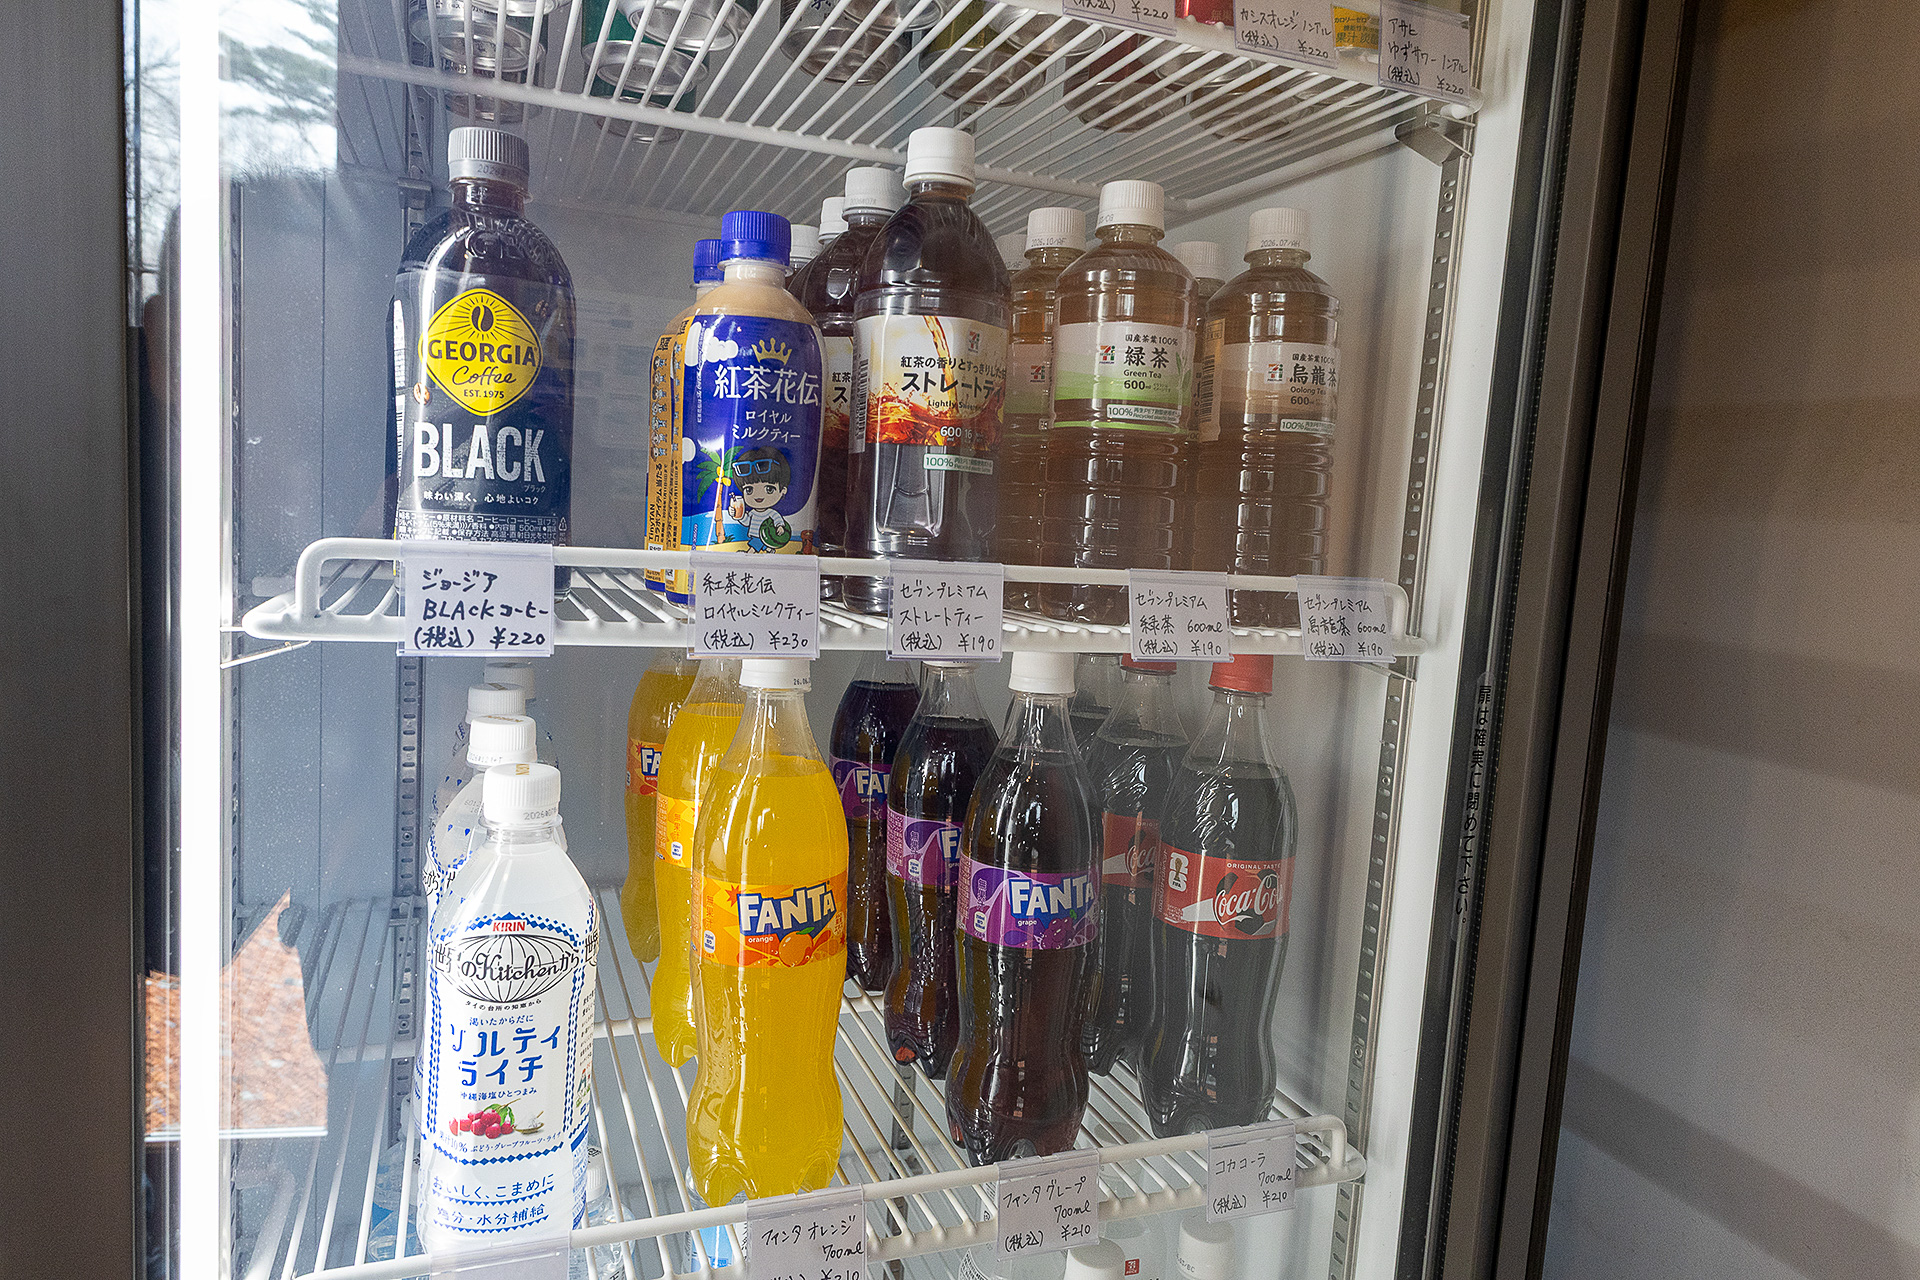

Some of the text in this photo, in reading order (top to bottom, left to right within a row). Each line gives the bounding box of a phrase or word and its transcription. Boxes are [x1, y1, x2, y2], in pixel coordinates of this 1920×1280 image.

[1241, 30, 1329, 59] (税込) ¥220
[1387, 67, 1464, 96] (税込) ¥220
[1125, 334, 1178, 346] 国産茶葉100%
[428, 339, 537, 367] GEORGIA
[1124, 346, 1169, 369] 緑茶
[452, 365, 517, 387] Coffee
[1124, 369, 1161, 379] Green Tea
[463, 389, 504, 399] EST. 1975
[713, 364, 819, 407] 紅茶花伝
[1290, 386, 1315, 395] Oolong
[745, 409, 792, 425] ロイヤル
[1108, 407, 1133, 417] 100%
[732, 424, 800, 443] ミルクティー
[940, 426, 962, 438] 600
[413, 421, 546, 483] BLACK
[926, 457, 954, 468] 100%
[523, 485, 546, 493] ブラック
[422, 568, 498, 593] ジョージア
[702, 572, 776, 595] 紅茶花伝
[900, 580, 988, 600] セブンプレミアム
[1135, 589, 1208, 610] セブンプレミアム
[704, 602, 815, 621] ロイヤルミルクティー
[900, 607, 983, 626] ストレートティー
[1140, 615, 1175, 635] 緑茶
[414, 625, 546, 650] (税込) ¥220
[704, 629, 808, 650] (税込) ¥230
[900, 631, 994, 652] (税込) ¥190
[1138, 639, 1221, 656] (税込) ¥190
[1310, 641, 1383, 657] (税込) ¥190
[1455, 685, 1492, 924] 扉は確実に閉めて下さい。
[1227, 862, 1261, 870] ORIGINAL
[1011, 875, 1095, 916] FANTA
[739, 885, 836, 933] FANTA
[492, 921, 526, 932] KIRIN
[450, 1023, 561, 1059] ソルティ
[459, 1054, 543, 1087] ライチ
[1215, 1152, 1266, 1175] コカコーラ
[433, 1173, 554, 1199] おいしく、こまめに
[1046, 1175, 1086, 1200] グレープ
[1212, 1190, 1288, 1214] (税込) ¥210
[808, 1215, 856, 1240] オレンジ
[1005, 1224, 1091, 1252] (税込) ¥210
